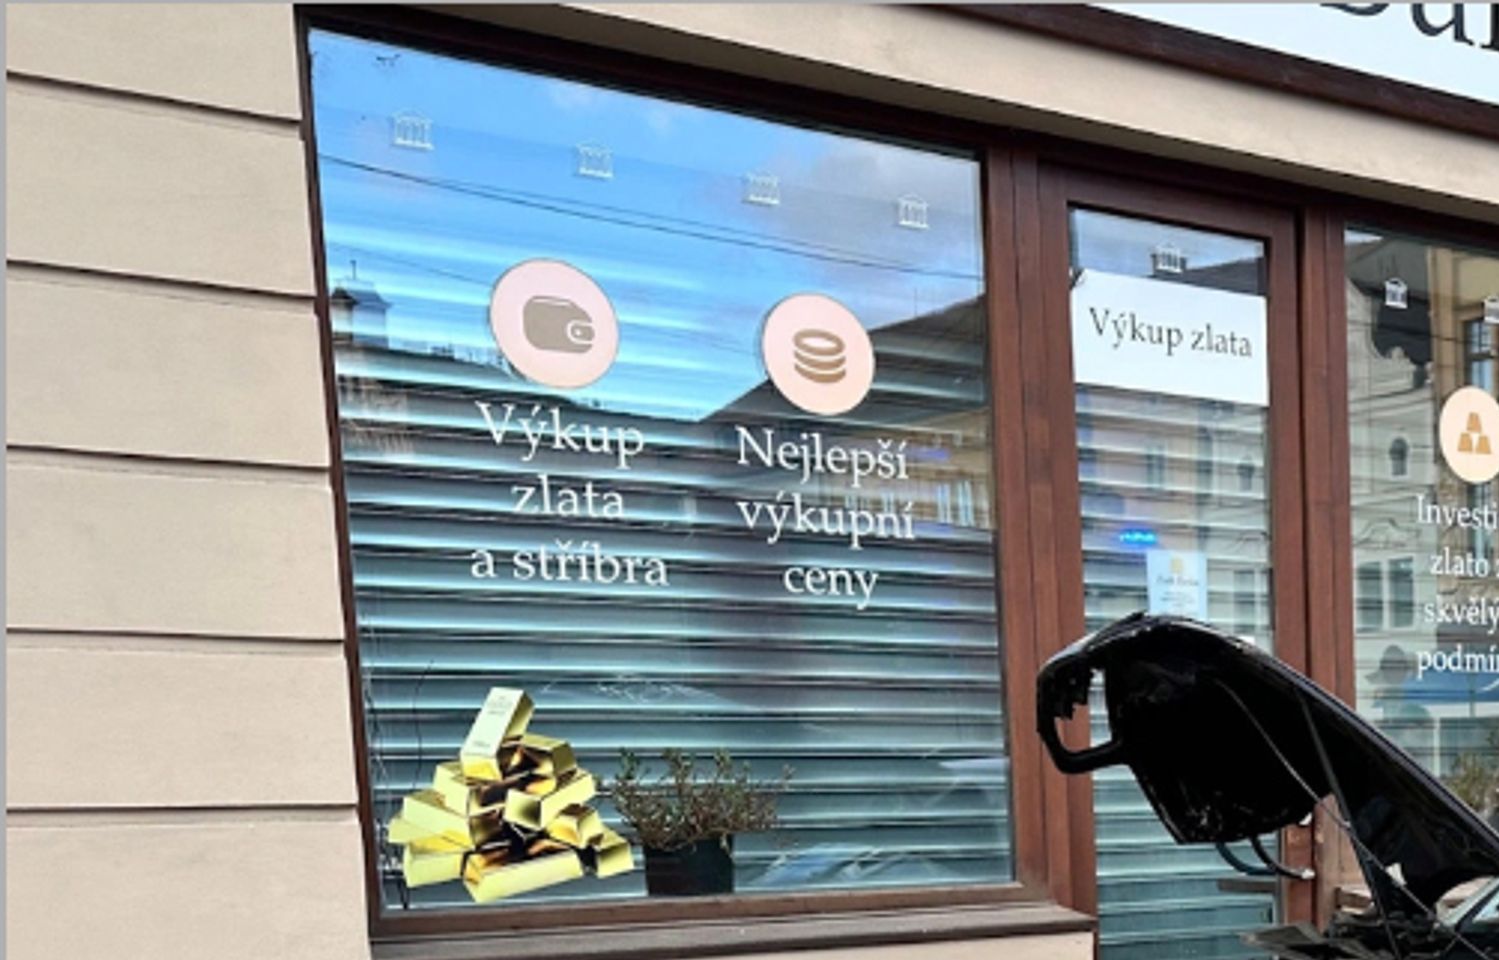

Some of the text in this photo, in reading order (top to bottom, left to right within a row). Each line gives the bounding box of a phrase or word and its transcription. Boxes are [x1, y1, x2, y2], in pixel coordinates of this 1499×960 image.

[1089, 305, 1252, 358] Výkup zlata
[475, 400, 645, 470] Výkup
[735, 424, 910, 489] Nejlepší
[509, 473, 625, 519] zlata
[736, 490, 916, 550] výkupní
[471, 539, 670, 587] a stříbra
[1429, 546, 1491, 579] zlato
[783, 566, 880, 610] ceny
